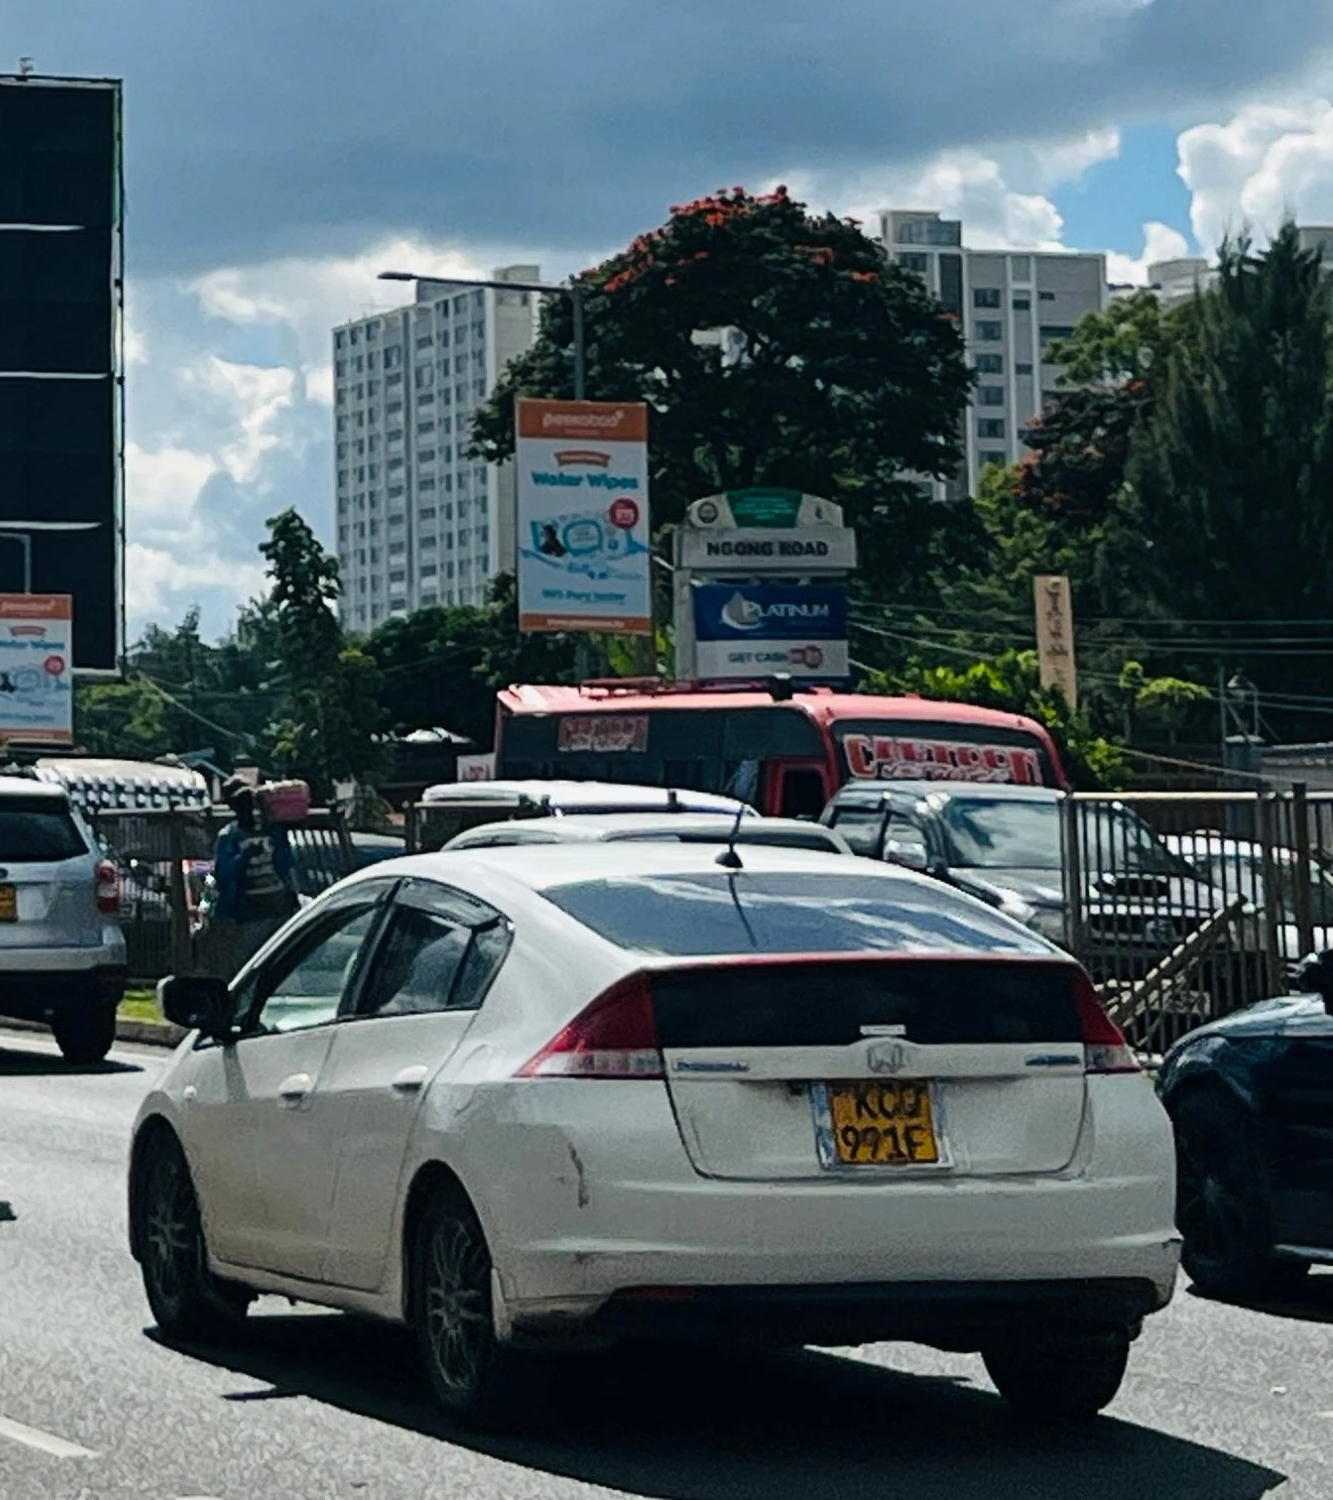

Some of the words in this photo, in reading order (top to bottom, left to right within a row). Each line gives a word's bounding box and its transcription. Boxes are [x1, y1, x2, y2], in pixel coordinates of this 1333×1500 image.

[532, 471, 584, 488] Water
[586, 473, 639, 490] Wipes
[707, 541, 774, 557] NGONG
[779, 541, 829, 557] ROAD
[742, 601, 829, 617] PLATINUM
